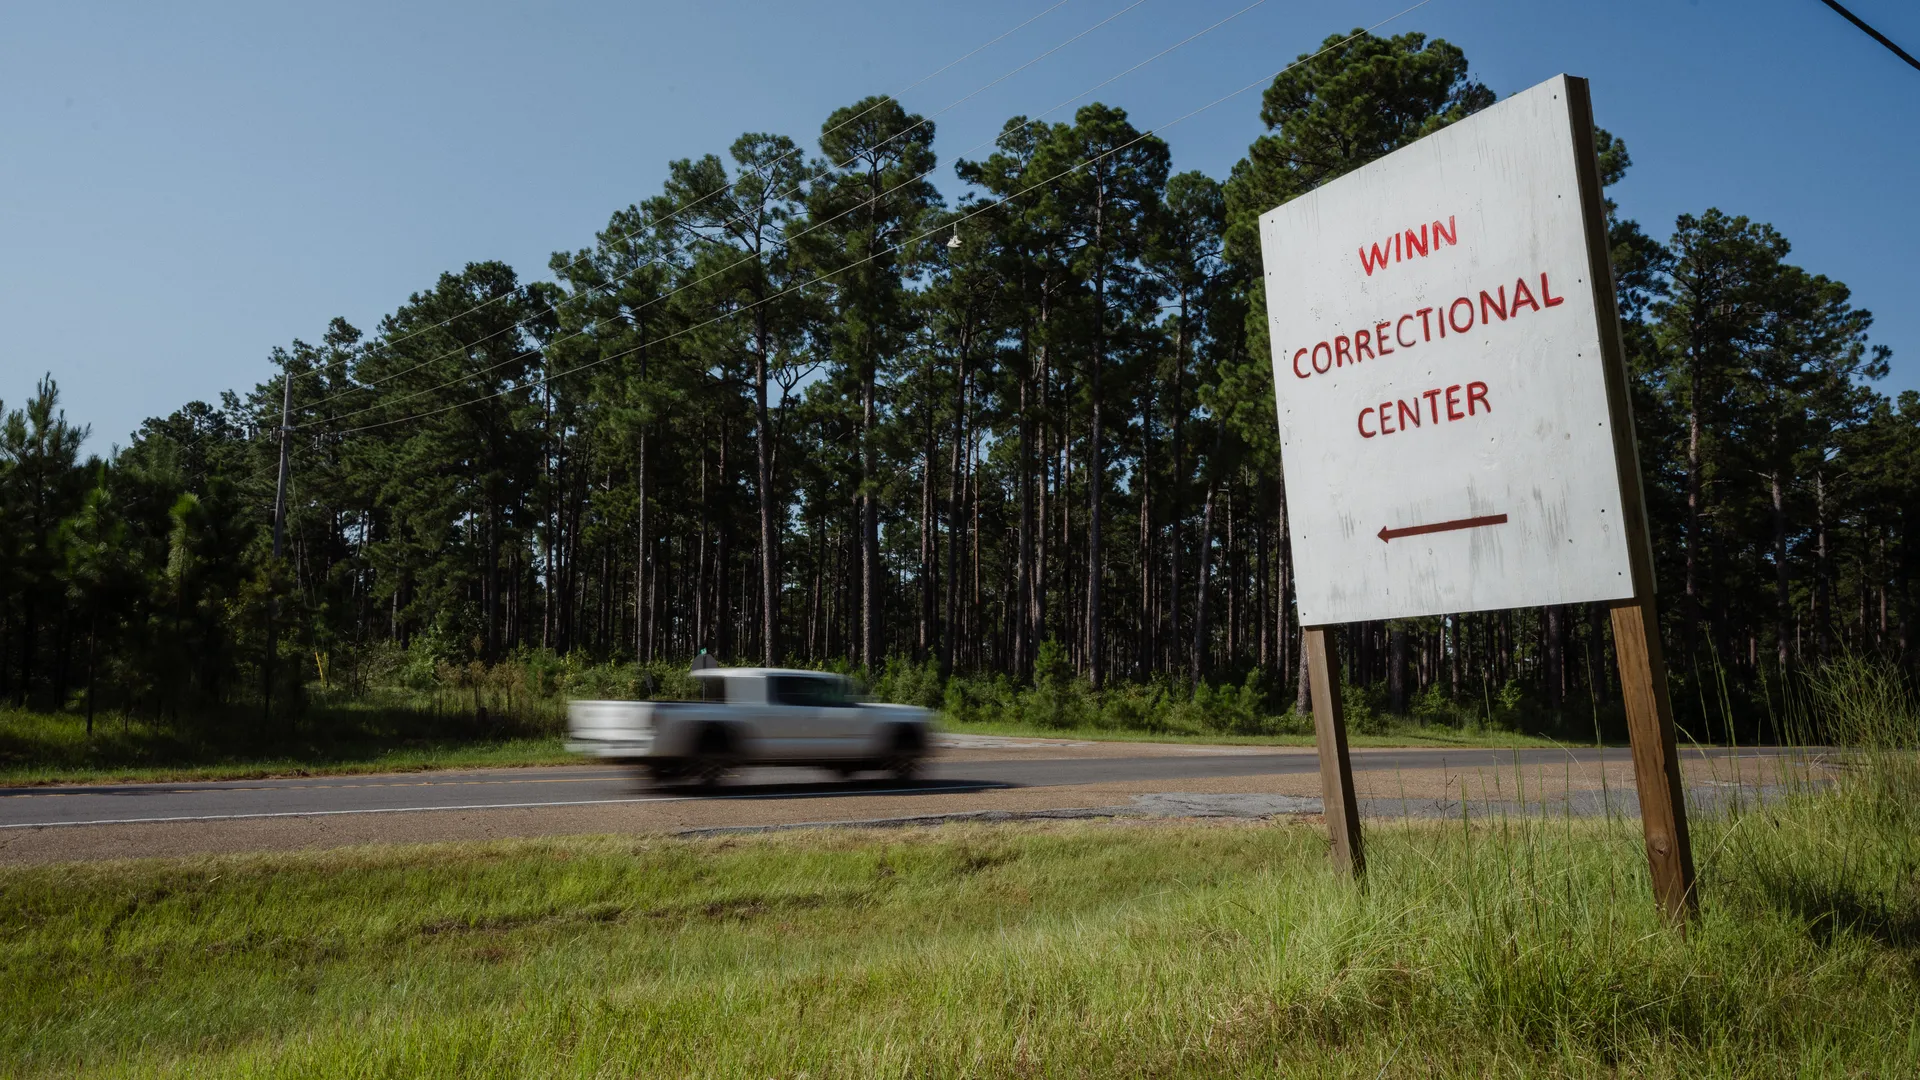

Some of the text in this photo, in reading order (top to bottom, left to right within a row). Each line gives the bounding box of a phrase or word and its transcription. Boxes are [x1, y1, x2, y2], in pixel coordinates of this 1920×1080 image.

[1358, 215, 1458, 276] WINN
[1293, 272, 1564, 379] CORRECTIONAL
[1358, 381, 1492, 438] CENTER
